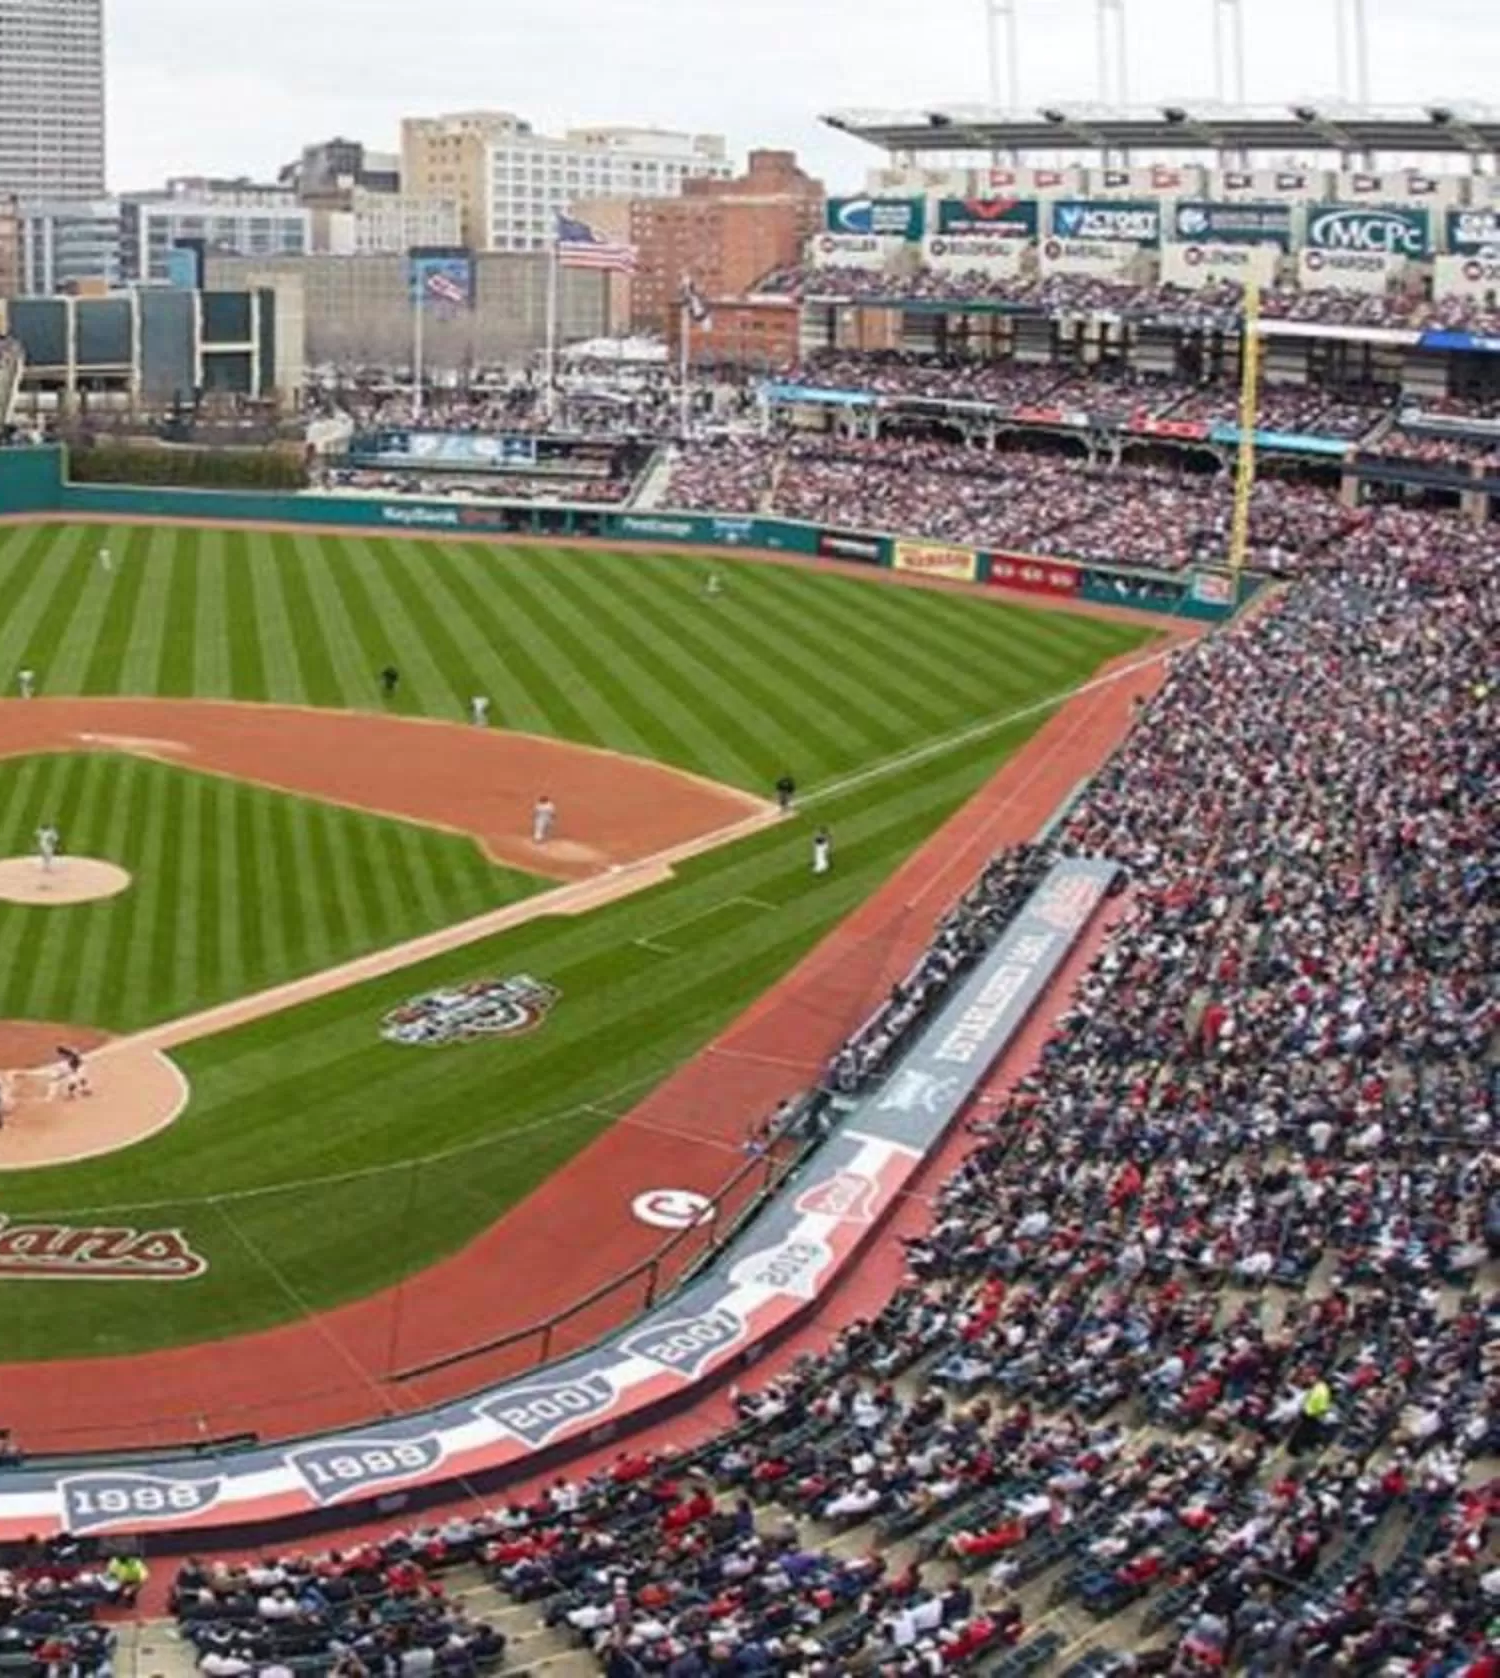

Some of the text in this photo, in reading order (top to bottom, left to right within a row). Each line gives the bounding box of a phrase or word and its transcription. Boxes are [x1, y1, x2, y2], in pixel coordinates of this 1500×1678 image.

[649, 1308, 740, 1363] 2007
[502, 1378, 615, 1432] 2001
[306, 1438, 429, 1486] 1999
[71, 1486, 202, 1514] 1998
